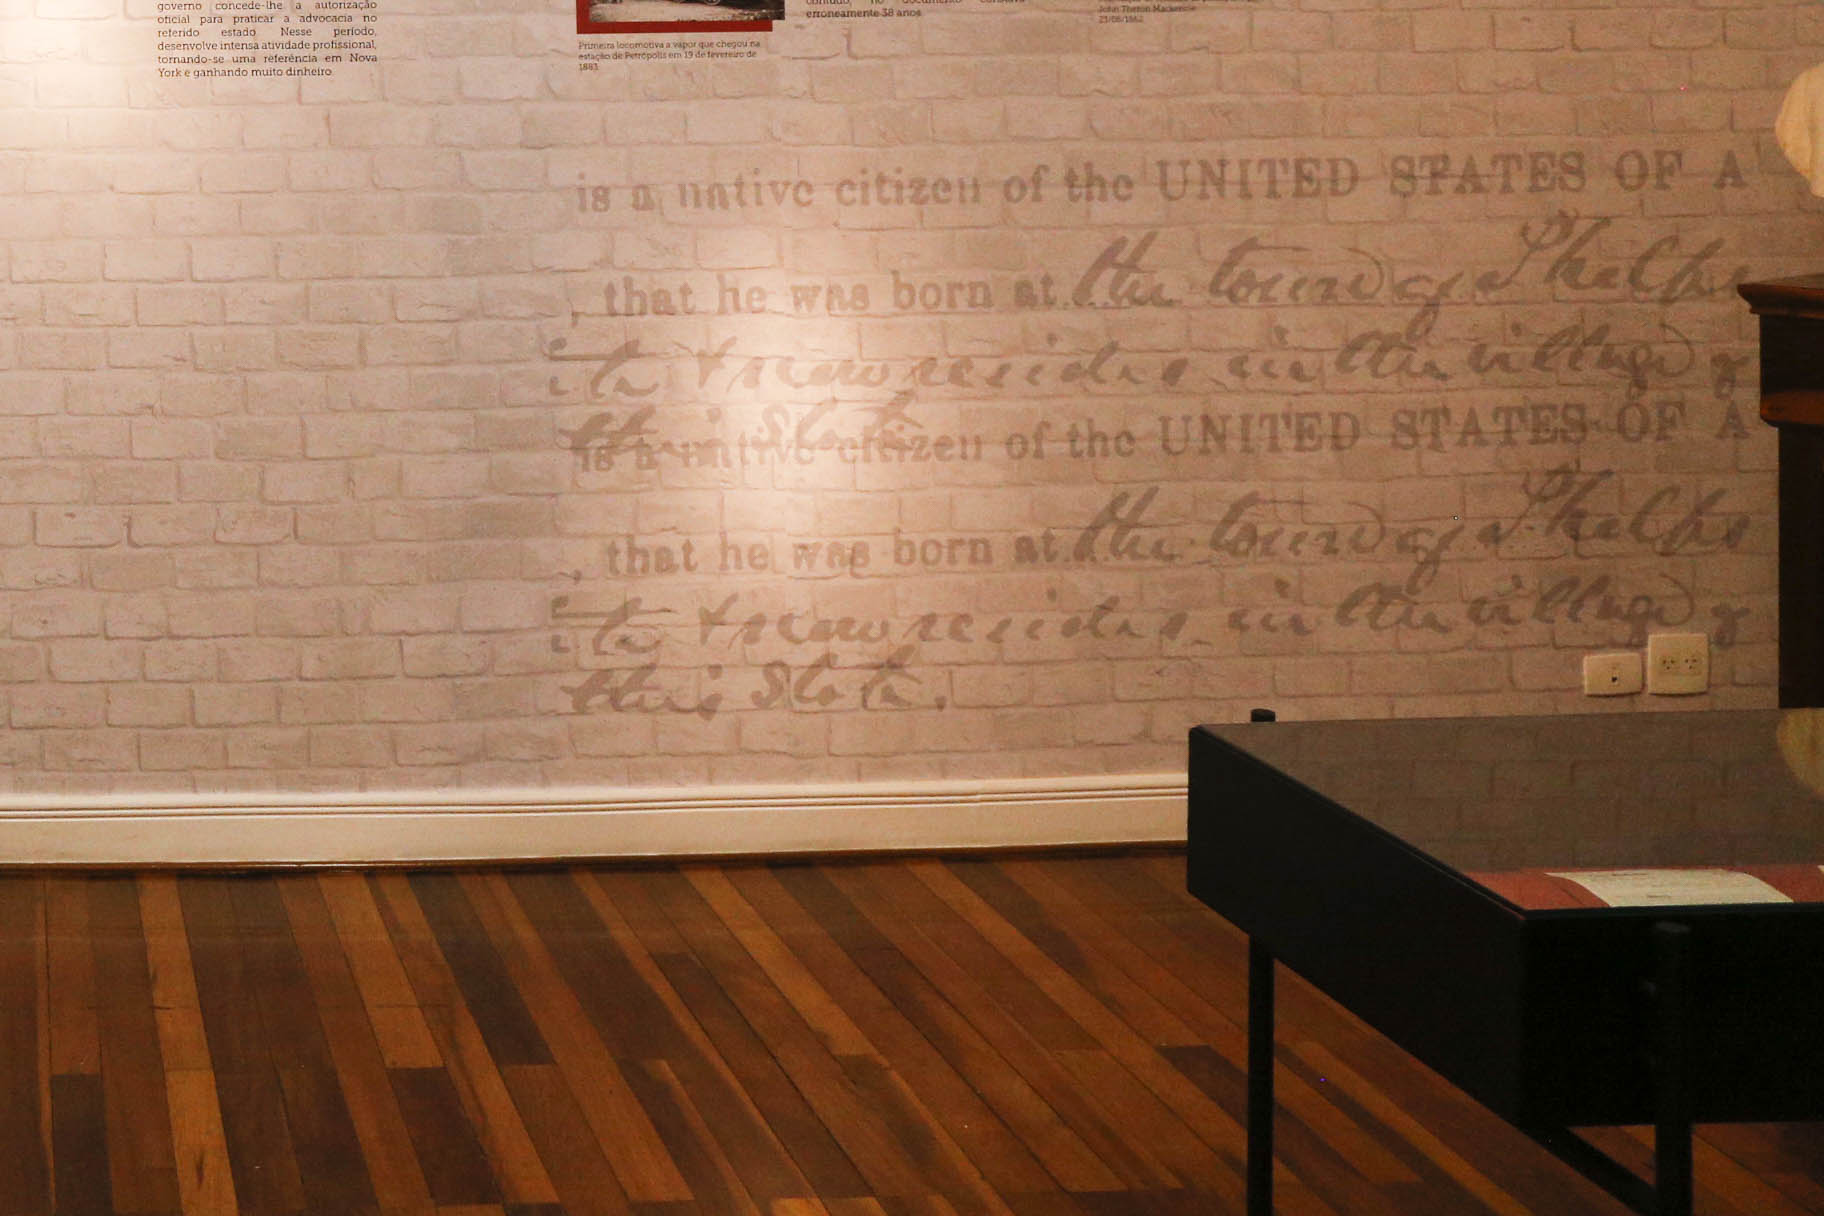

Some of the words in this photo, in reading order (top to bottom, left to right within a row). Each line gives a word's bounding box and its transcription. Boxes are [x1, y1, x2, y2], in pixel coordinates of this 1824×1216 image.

[157, 3, 203, 13] governo
[215, 0, 283, 10] concede-lhe
[295, 2, 302, 10] a
[315, 0, 377, 12] autorização
[157, 40, 218, 50] desenvolve
[219, 40, 260, 50] intensa
[261, 40, 311, 50] atividade
[312, 40, 376, 52] profissional,
[157, 67, 182, 77] York
[184, 69, 190, 77] e
[193, 67, 249, 79] ganhando
[251, 67, 284, 77] muito
[576, 174, 611, 213] is
[631, 188, 657, 212] a
[678, 168, 815, 211] native
[835, 169, 982, 206] citizen
[1002, 164, 1049, 204] of
[1066, 162, 1133, 202] the
[1156, 156, 1359, 202] UNITED
[1388, 151, 1588, 196] STATES
[1614, 148, 1684, 193] OF
[1713, 149, 1748, 189] A
[604, 275, 696, 316] that
[717, 273, 766, 314] he
[790, 283, 871, 312] was
[891, 270, 993, 311] born
[1005, 420, 1049, 461] of
[1067, 416, 1135, 458] the
[1158, 412, 1361, 457] UNITED
[1389, 402, 1588, 453] STATES
[1615, 400, 1686, 444] OF
[1715, 401, 1751, 441] A
[607, 536, 699, 577] that
[718, 533, 769, 572] he
[790, 539, 871, 570] was
[892, 528, 993, 568] born
